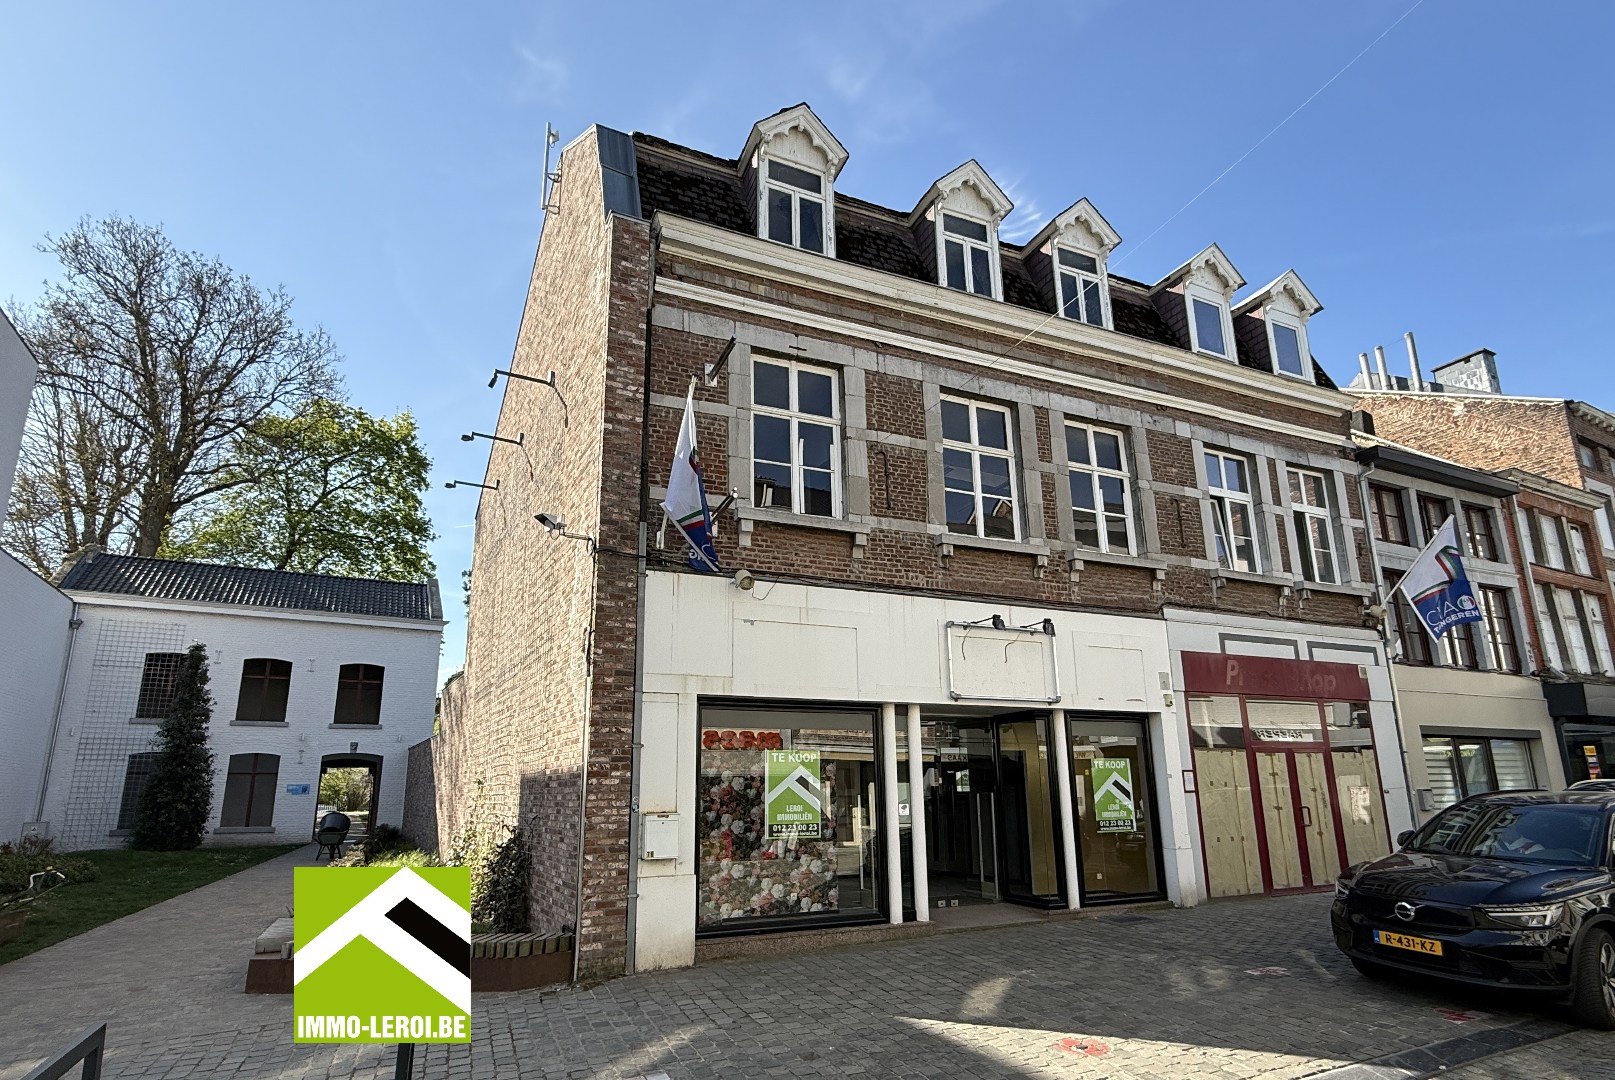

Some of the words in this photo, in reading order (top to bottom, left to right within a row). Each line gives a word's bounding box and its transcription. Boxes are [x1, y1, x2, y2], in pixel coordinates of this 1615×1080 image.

[772, 753, 785, 763] TE
[788, 753, 818, 763] KOOP
[1094, 761, 1104, 769] TE
[1105, 761, 1126, 769] KOOP
[1385, 934, 1436, 952] R-431-KZ
